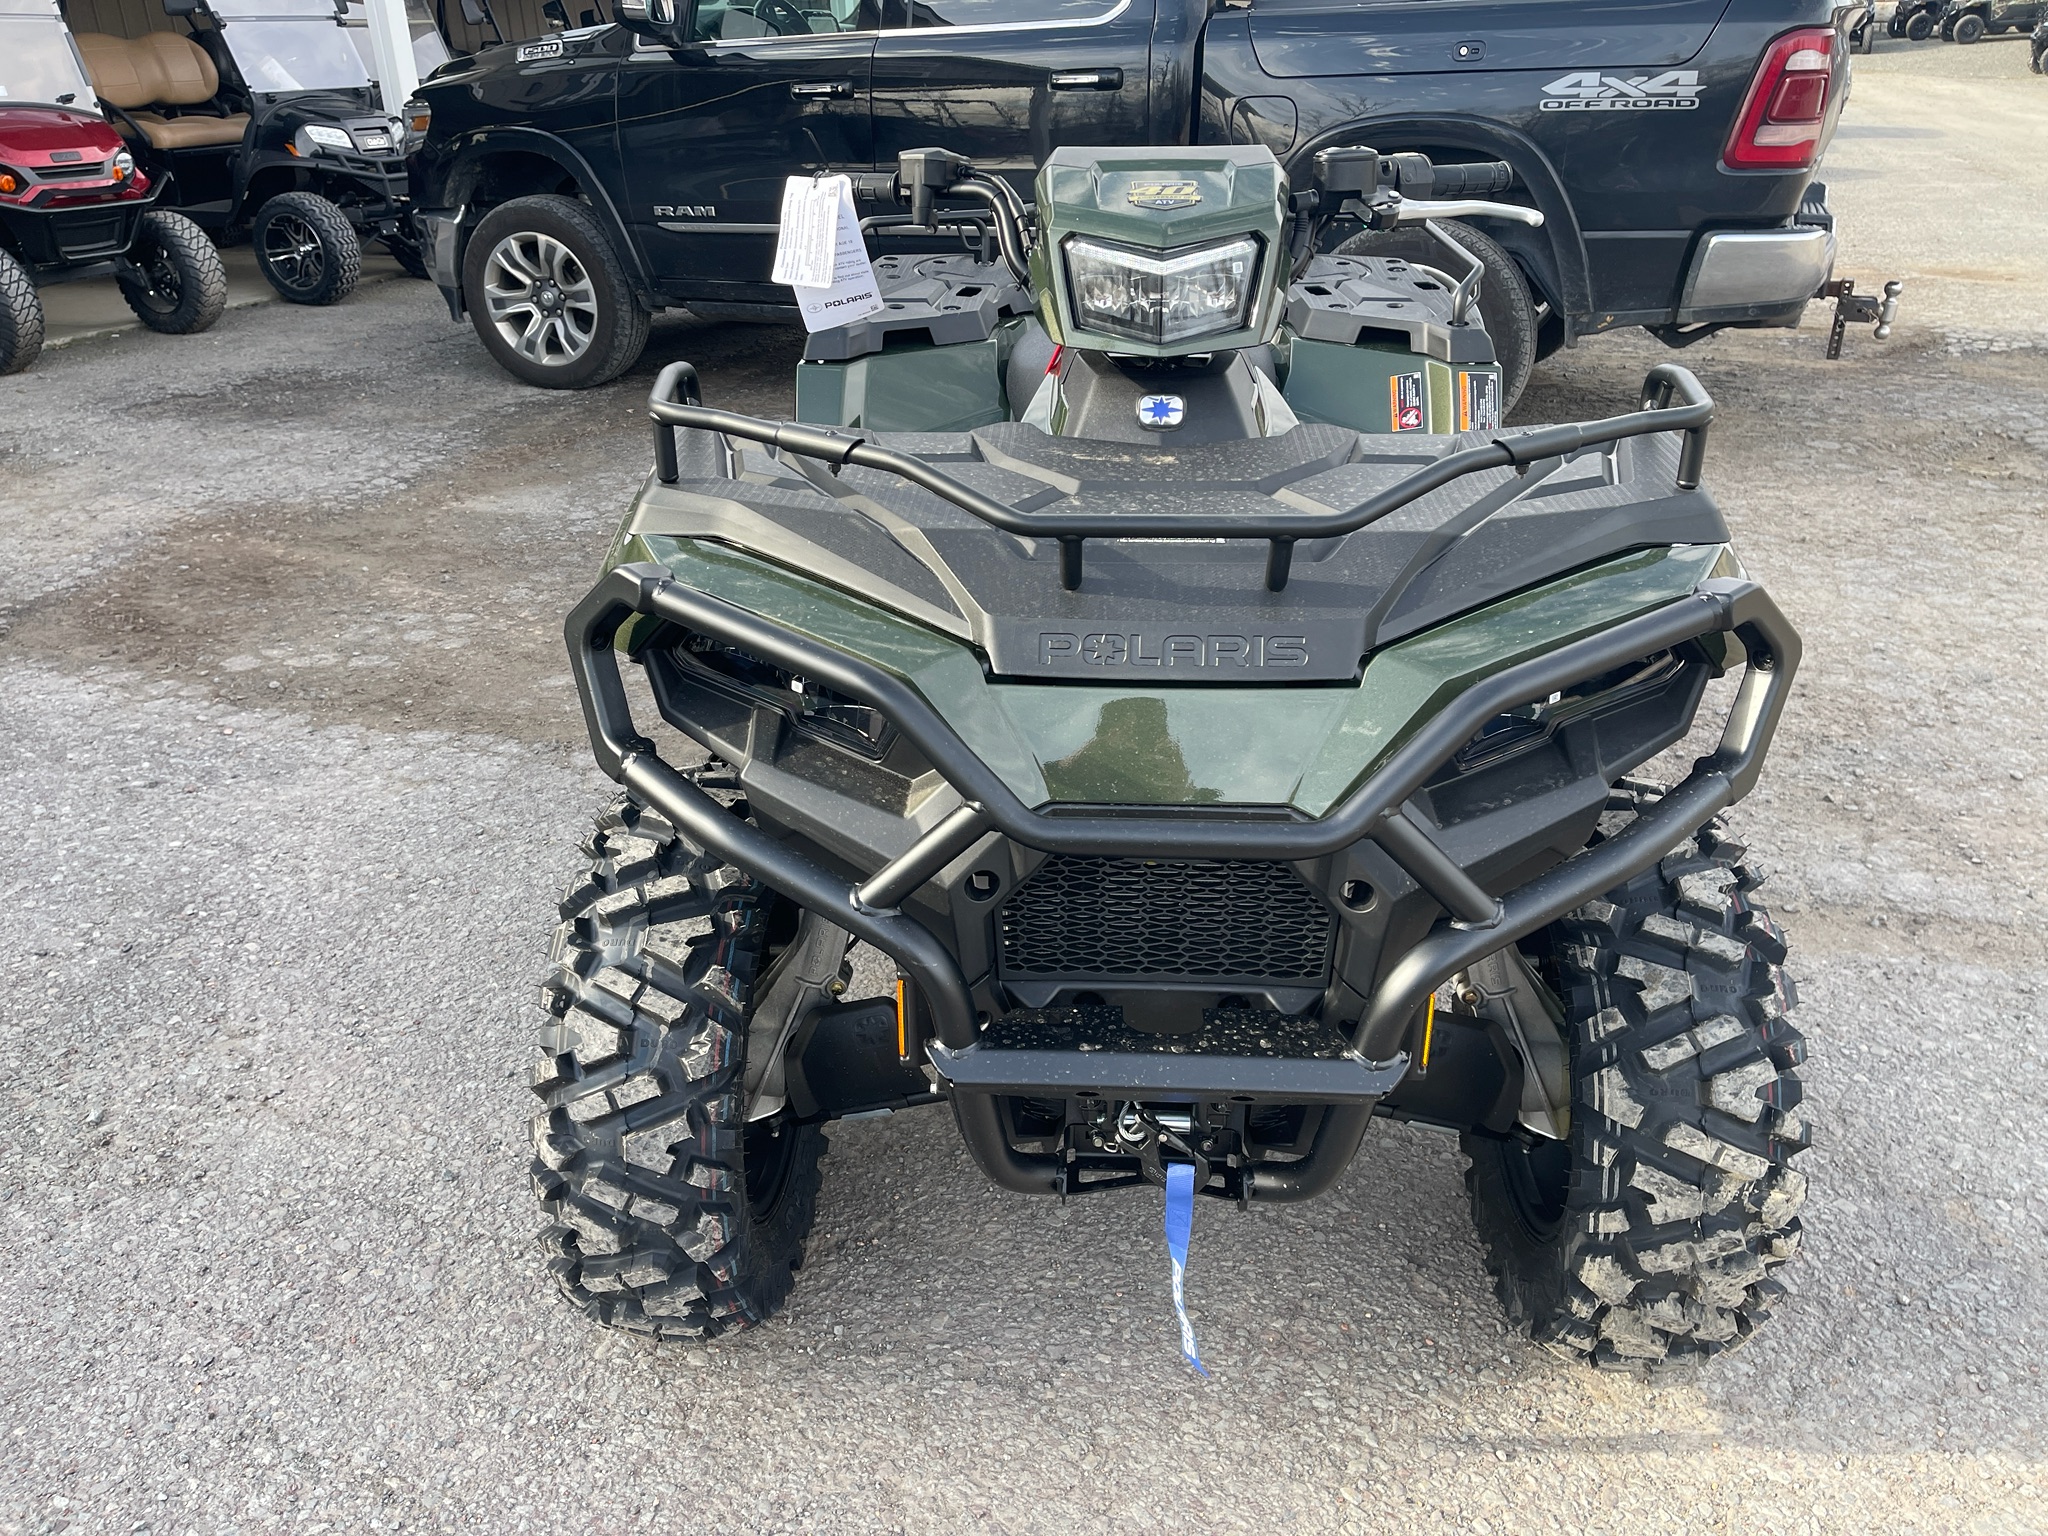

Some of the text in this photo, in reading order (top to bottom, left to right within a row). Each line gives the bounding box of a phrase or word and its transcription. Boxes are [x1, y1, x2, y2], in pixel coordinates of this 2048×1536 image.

[1542, 98, 1697, 109] OFF ROAD
[653, 205, 716, 218] RAM
[824, 292, 873, 309] POLARIS
[1039, 633, 1309, 668] POLARIS
